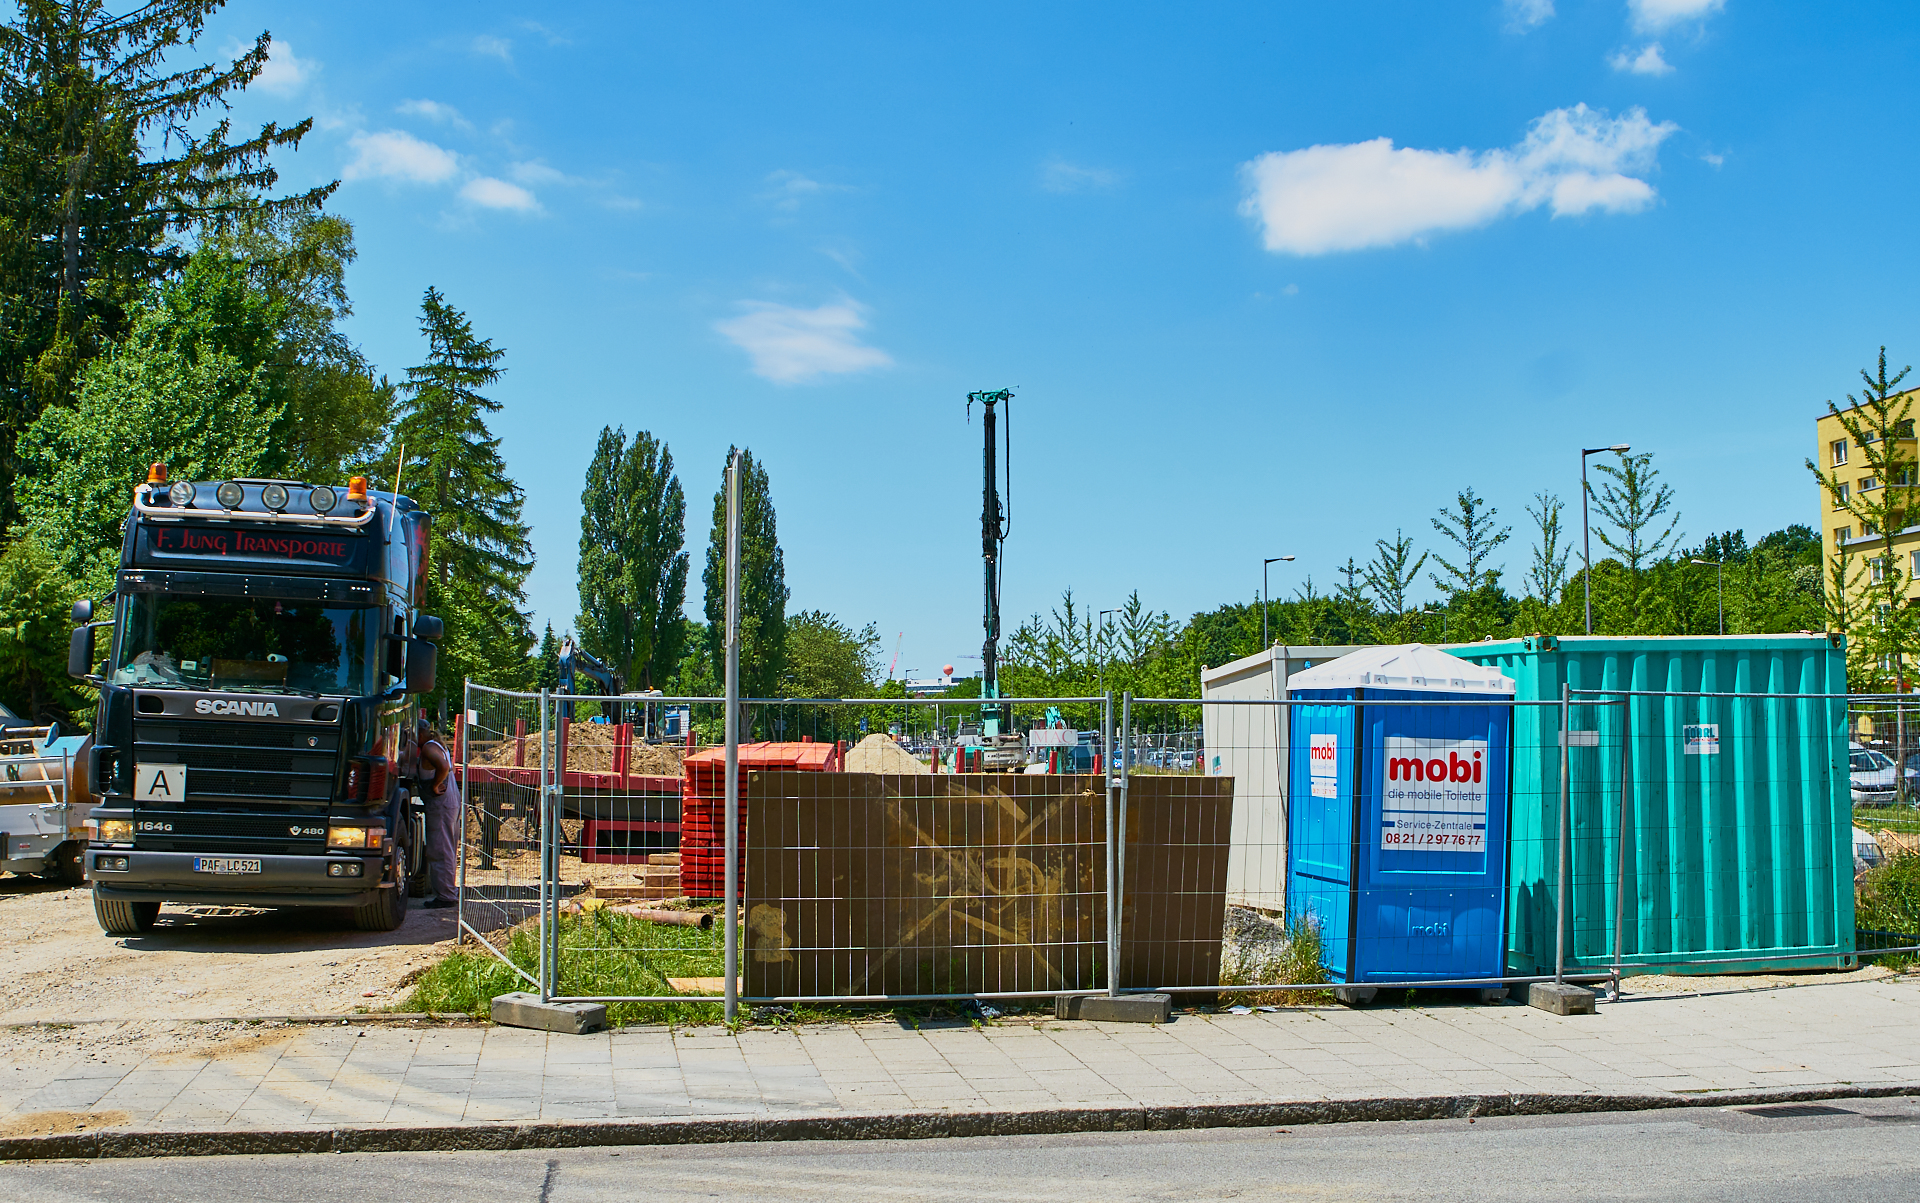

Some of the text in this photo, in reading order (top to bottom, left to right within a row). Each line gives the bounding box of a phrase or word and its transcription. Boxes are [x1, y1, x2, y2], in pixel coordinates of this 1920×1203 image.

[157, 528, 173, 548] F.
[194, 699, 280, 718] SCANIA
[1033, 730, 1073, 743] MAC
[1311, 741, 1335, 760] mobi
[1389, 750, 1482, 784] mobi
[148, 769, 171, 796] A
[1388, 788, 1482, 802] die mobile Toilette
[302, 827, 325, 835] 480
[1396, 819, 1472, 830] Service-Zentrale
[201, 859, 260, 872] PAF LC 521
[1411, 922, 1448, 937] mobi
